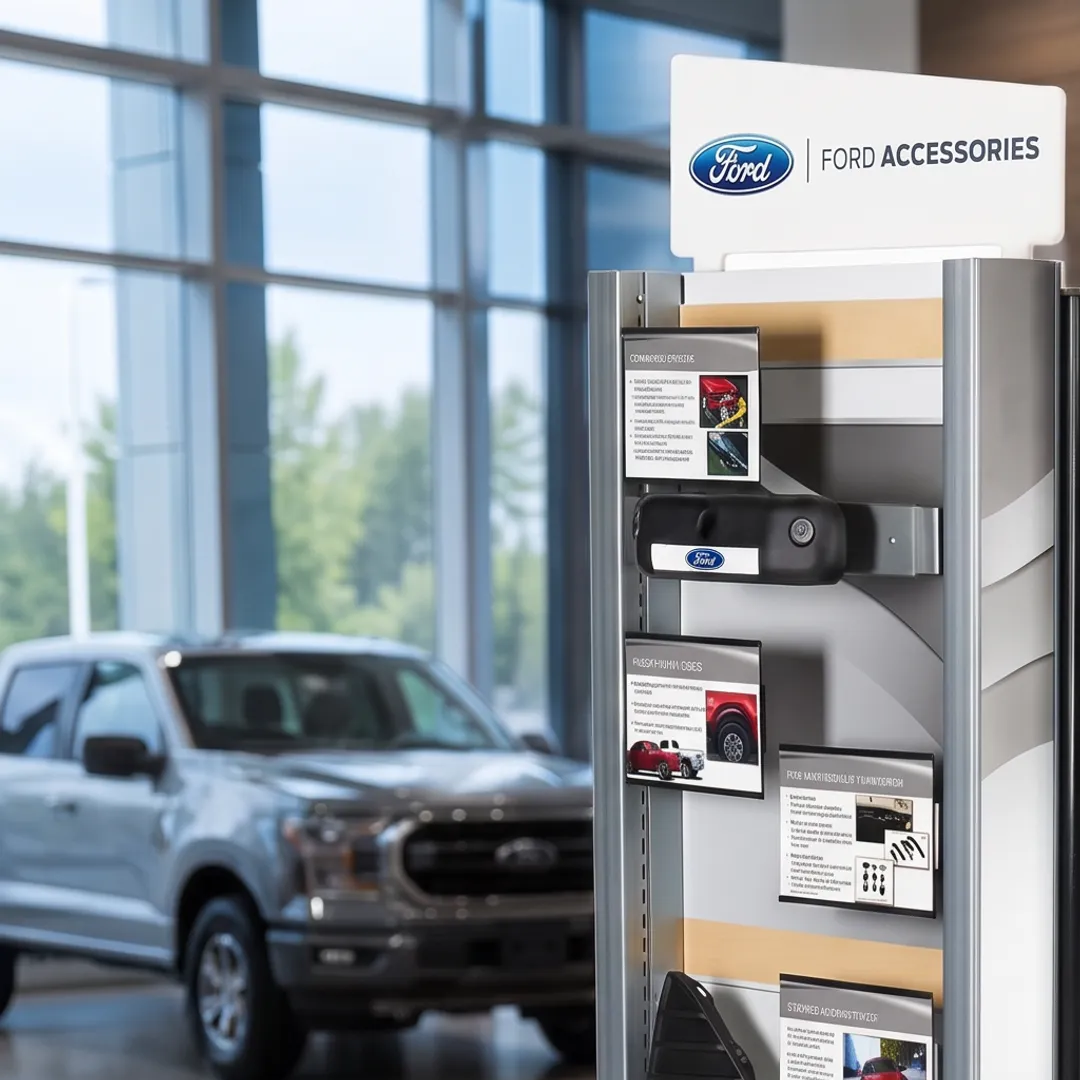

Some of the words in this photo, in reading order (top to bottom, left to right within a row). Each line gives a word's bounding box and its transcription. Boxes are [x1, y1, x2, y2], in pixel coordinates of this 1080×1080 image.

[709, 144, 773, 184] Ford
[822, 147, 875, 171] FORD
[881, 136, 1040, 167] ACCESSORIES
